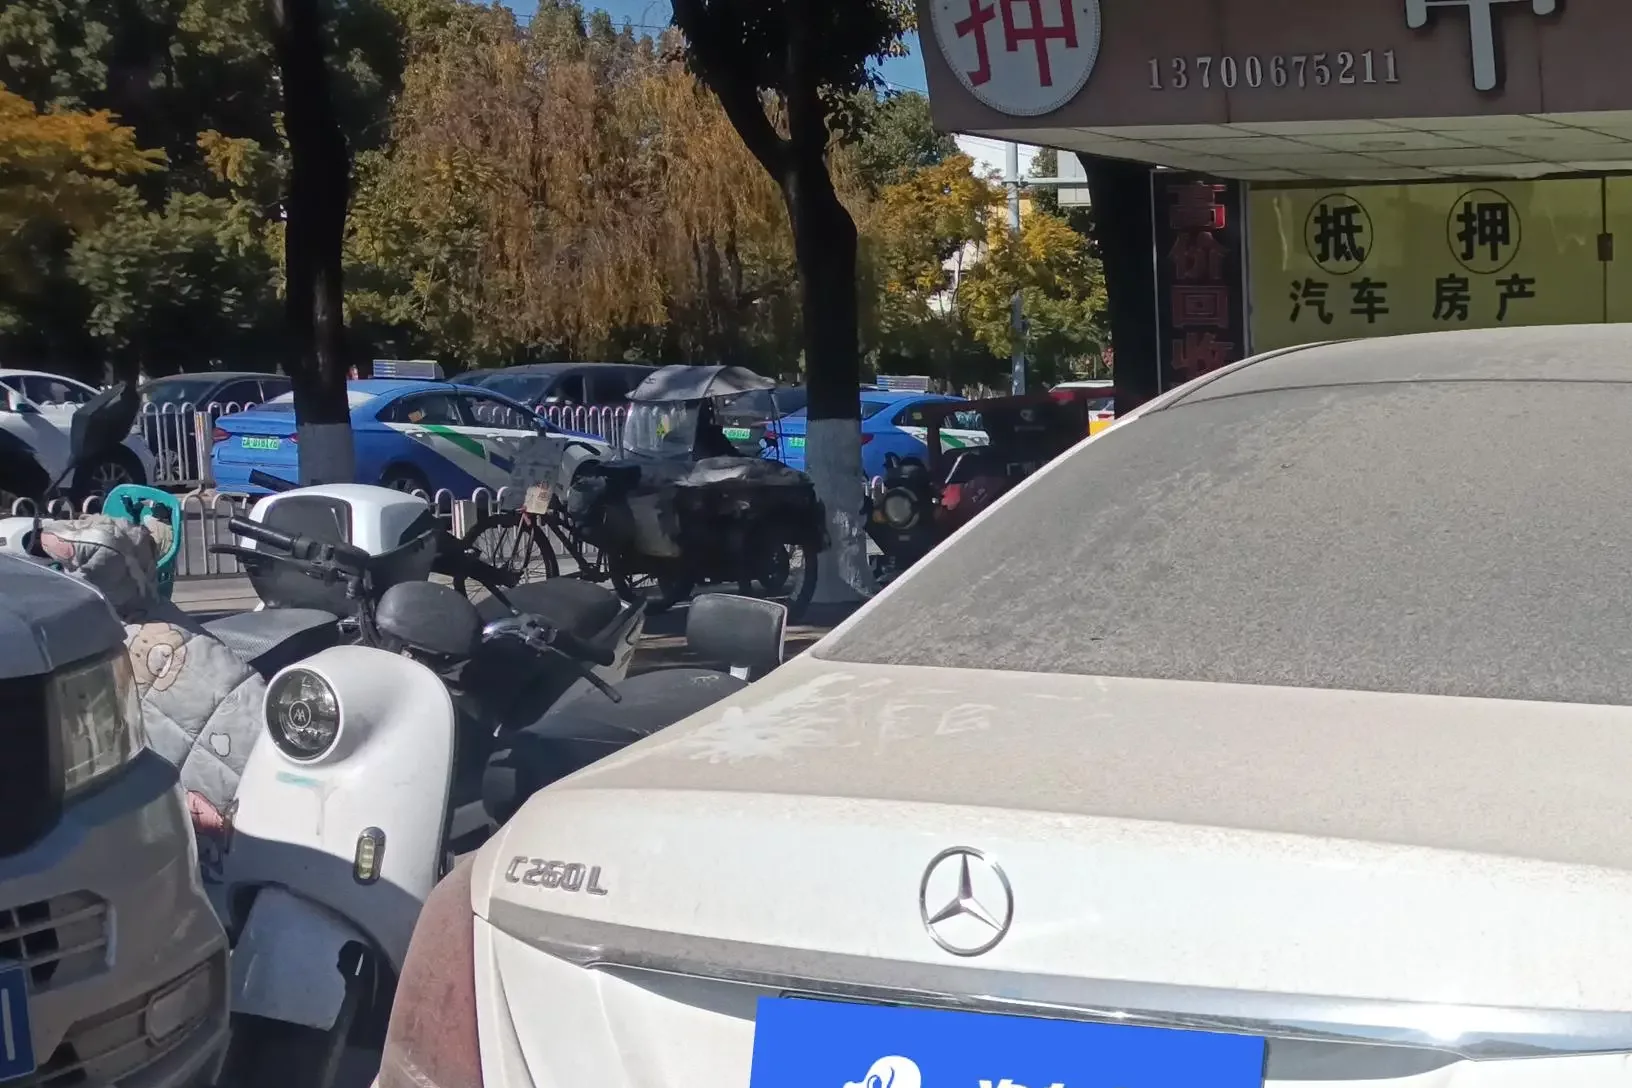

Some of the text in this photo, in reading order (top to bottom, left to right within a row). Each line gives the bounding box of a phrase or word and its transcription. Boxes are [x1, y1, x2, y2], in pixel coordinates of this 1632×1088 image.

[1148, 49, 1399, 89] 13700675211
[1289, 277, 1389, 325] 汽车
[1432, 273, 1536, 322] 房产
